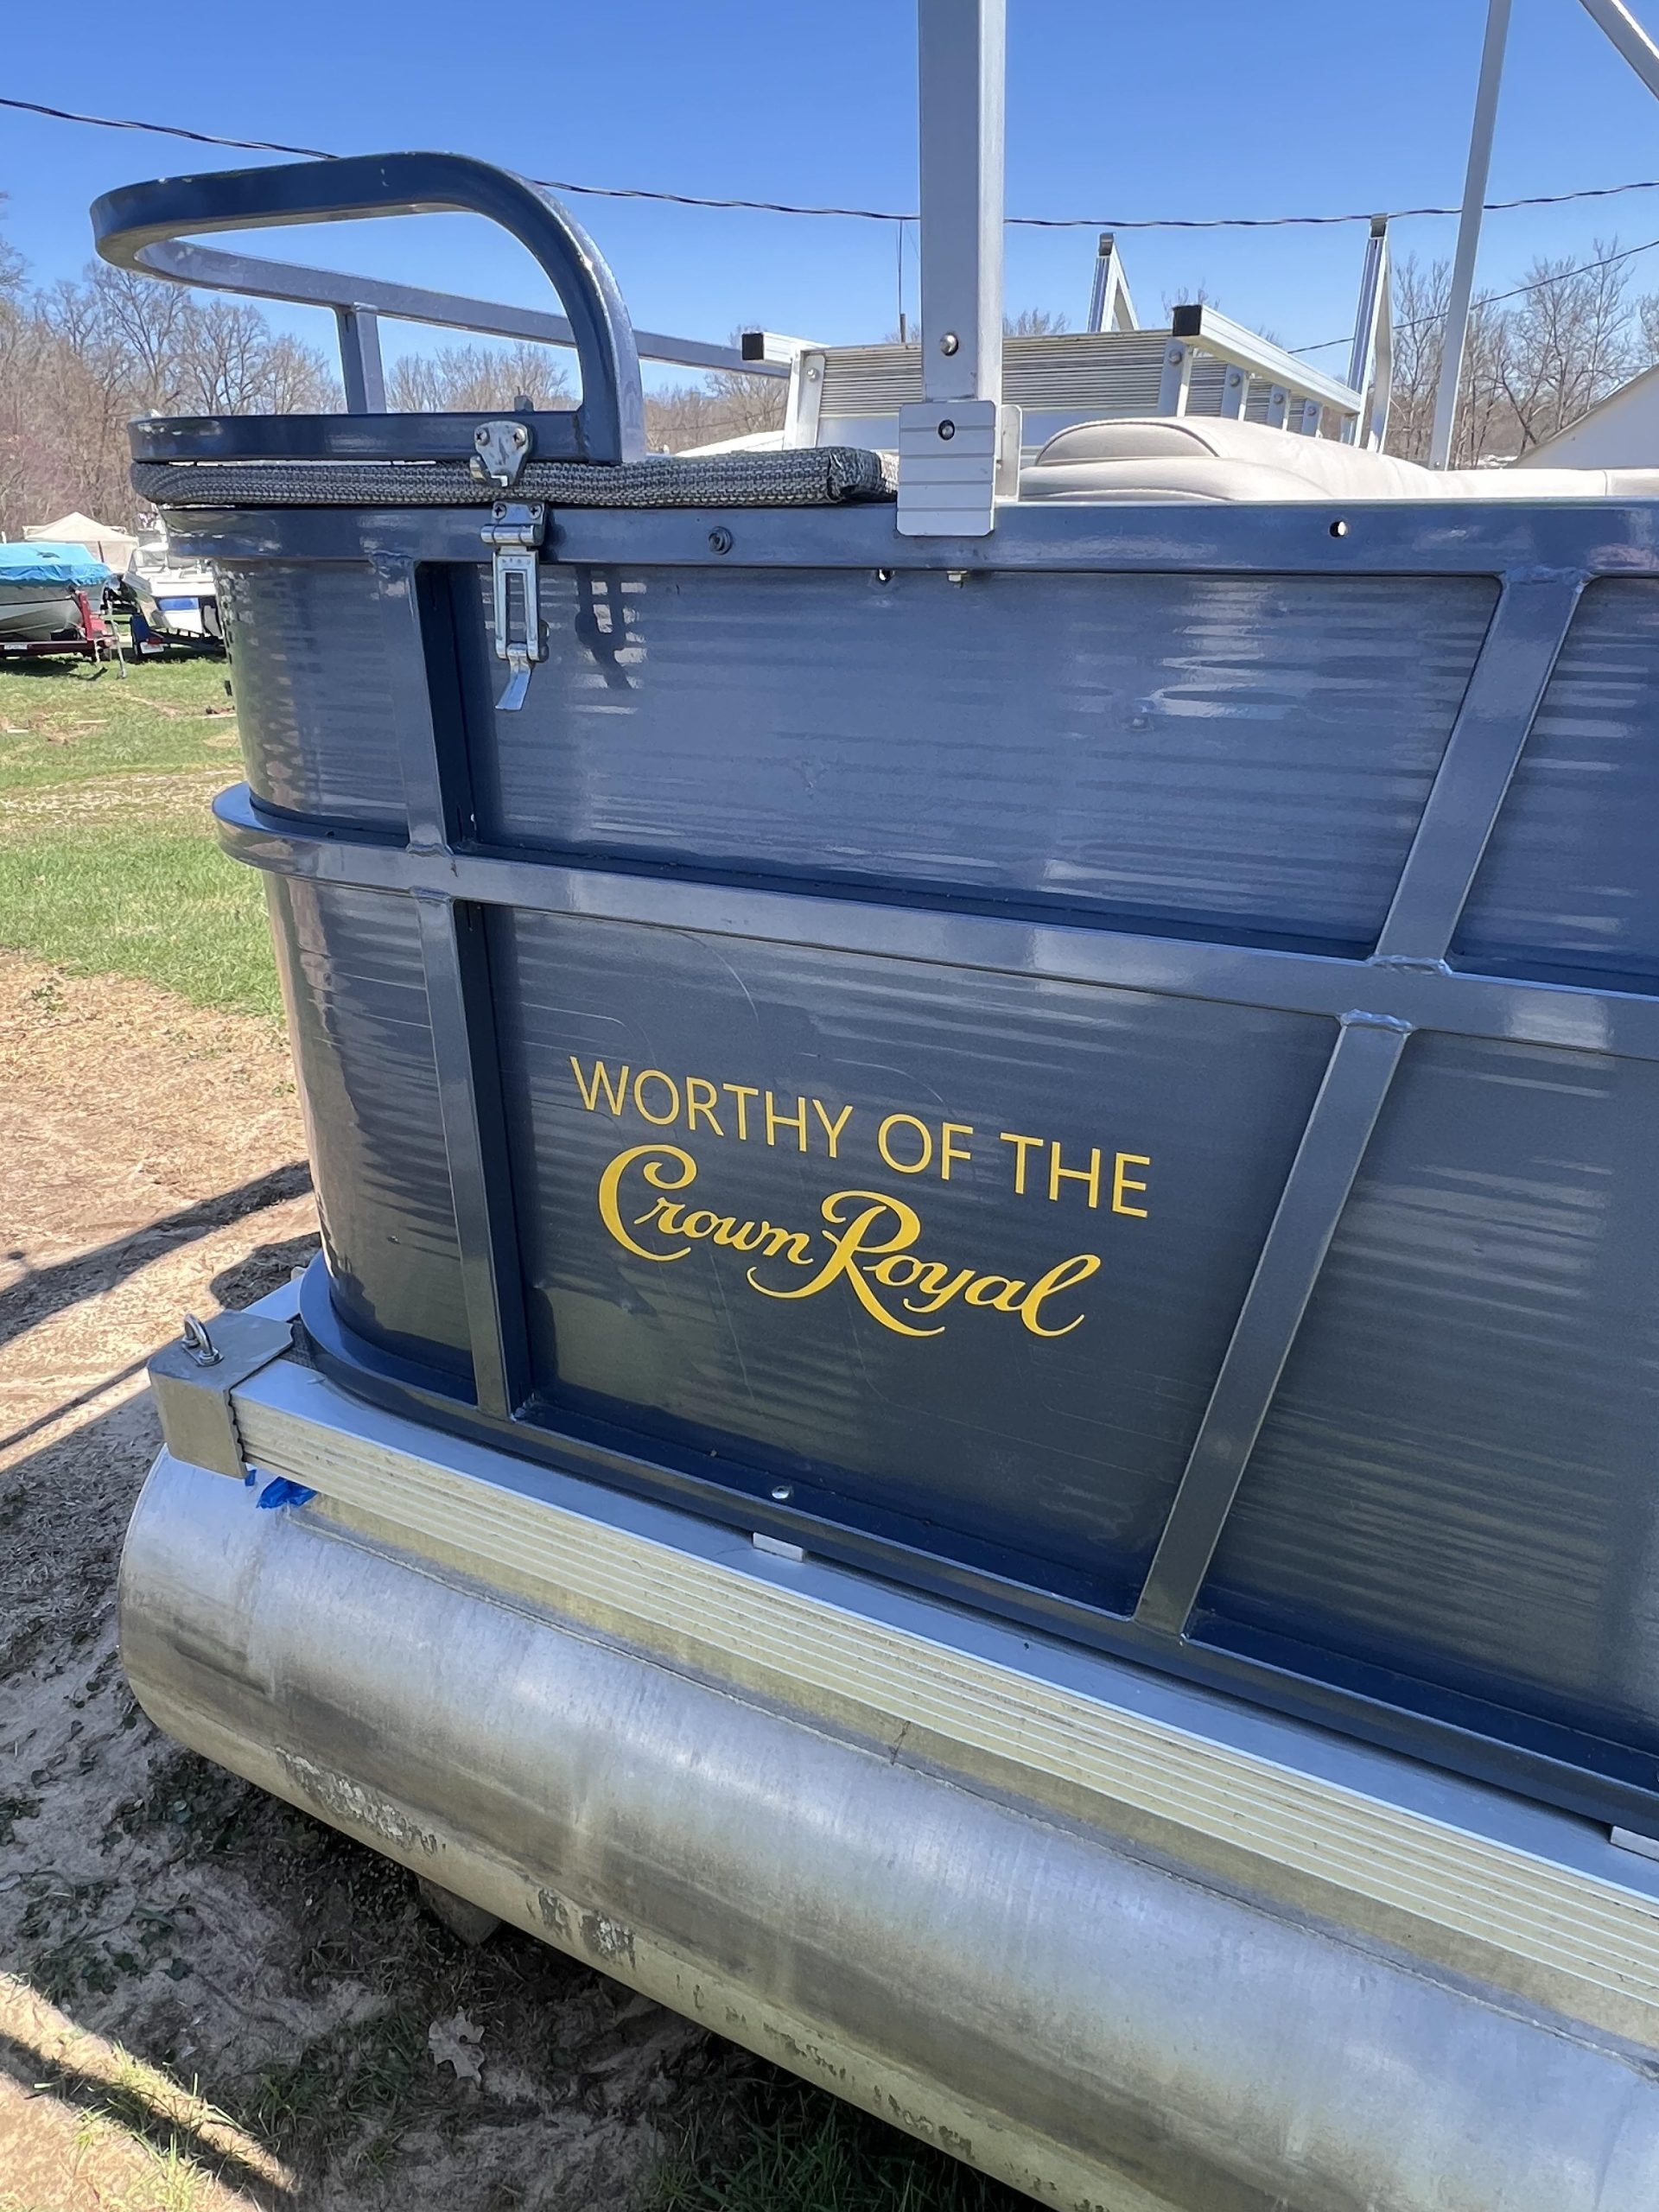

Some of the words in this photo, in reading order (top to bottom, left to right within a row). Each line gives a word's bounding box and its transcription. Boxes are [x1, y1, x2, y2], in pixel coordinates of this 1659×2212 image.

[569, 1056, 853, 1159] WORTHY
[877, 1113, 975, 1180] OF
[1000, 1131, 1151, 1218] THE
[598, 1144, 814, 1264] Crown
[746, 1189, 1102, 1338] Royal
